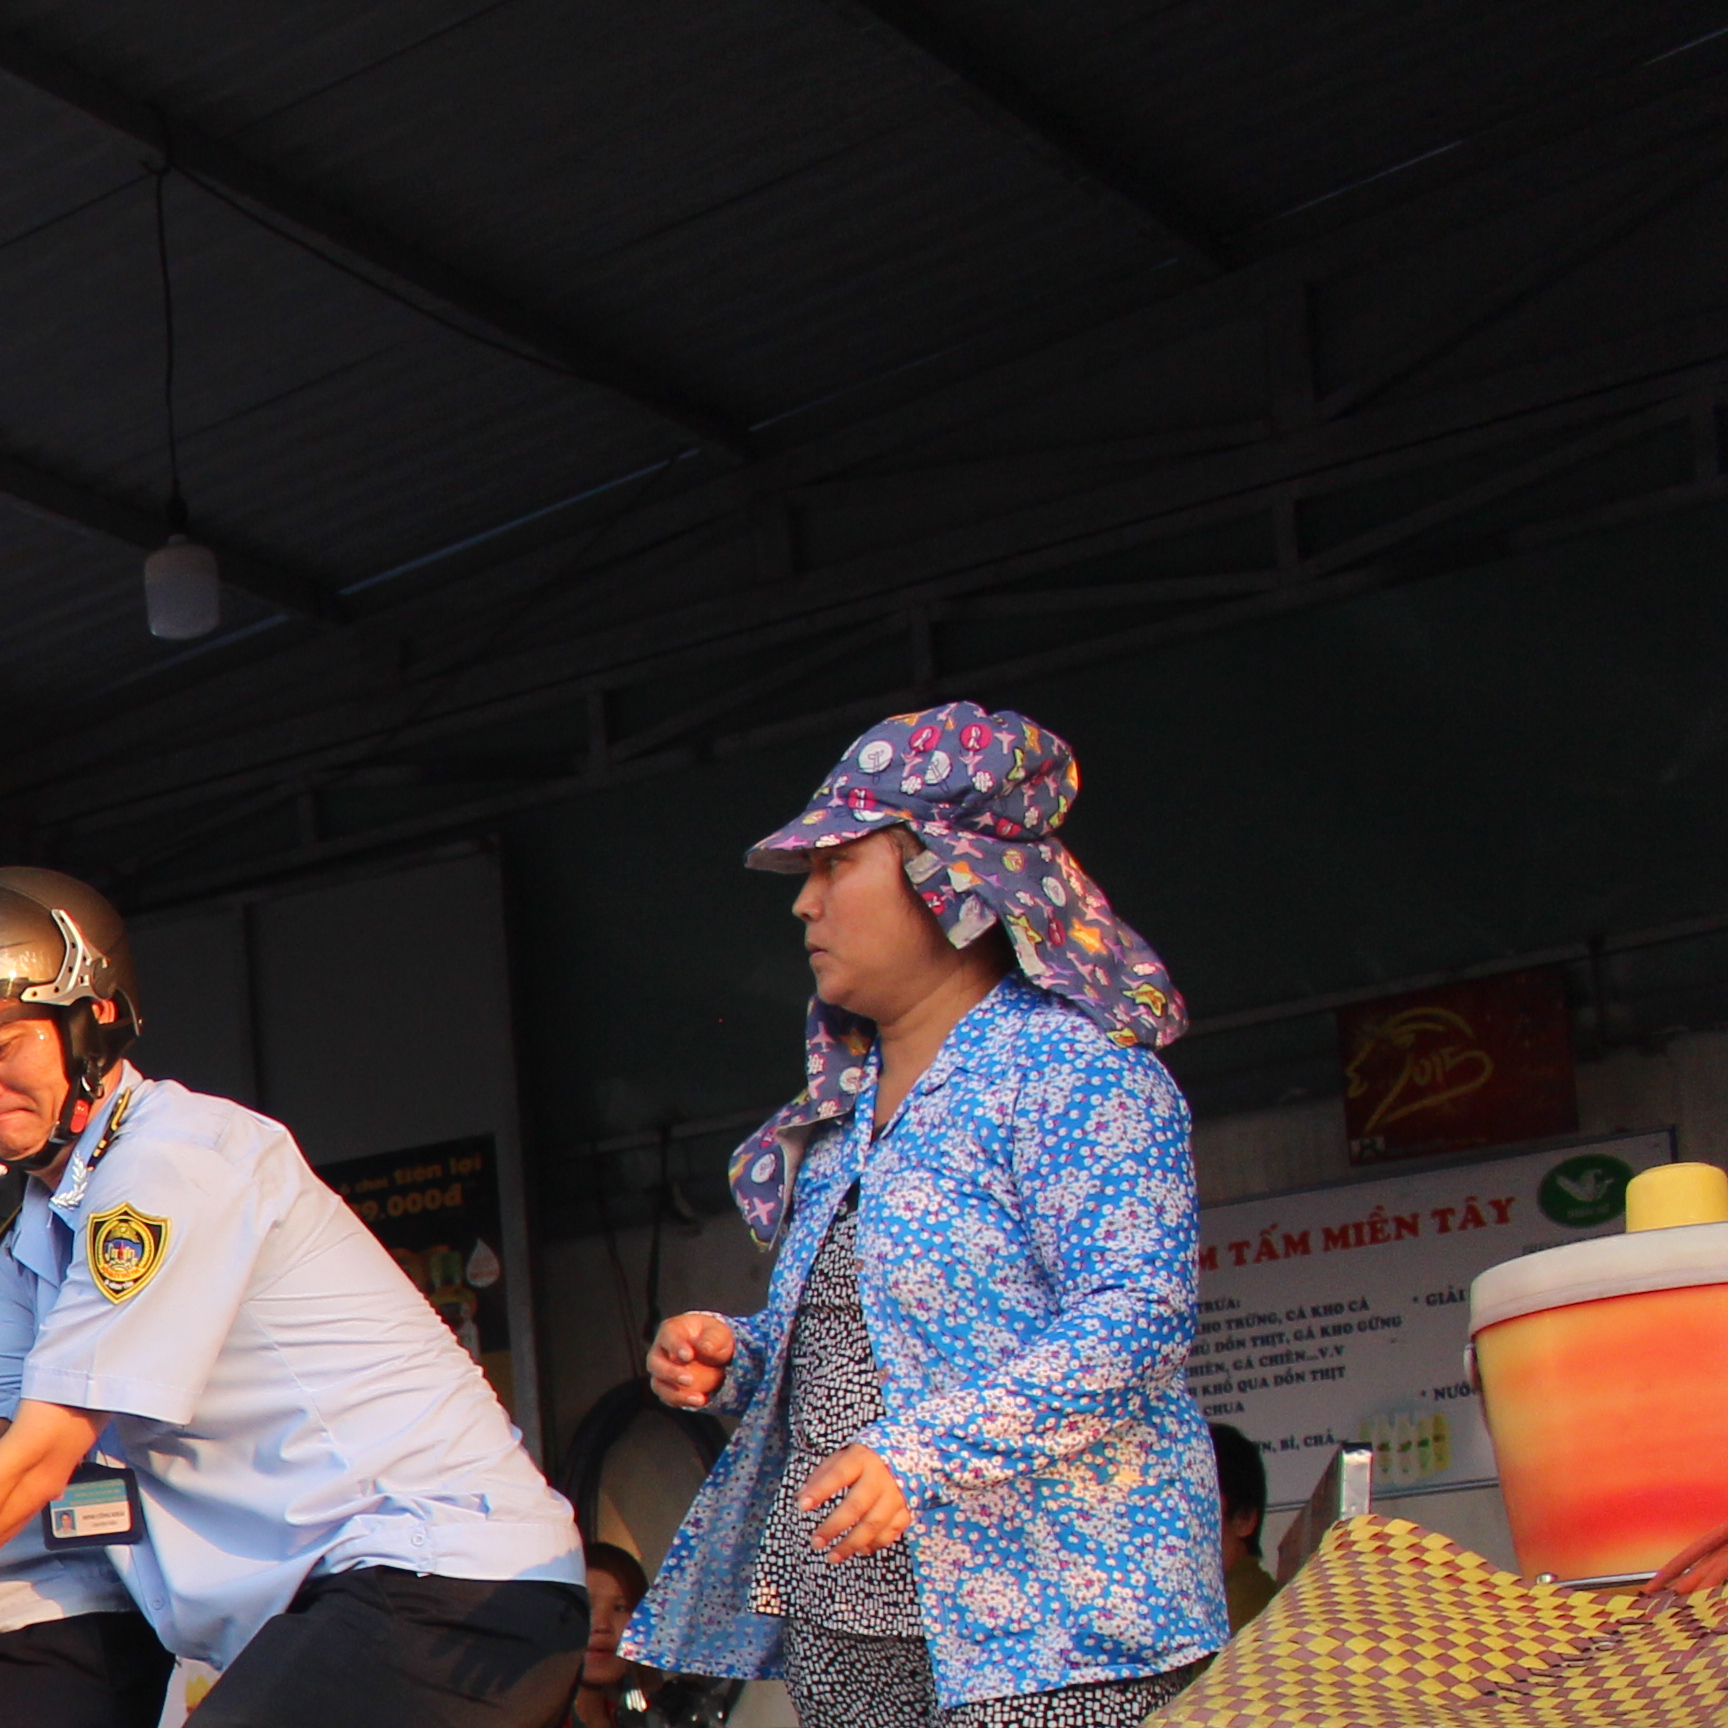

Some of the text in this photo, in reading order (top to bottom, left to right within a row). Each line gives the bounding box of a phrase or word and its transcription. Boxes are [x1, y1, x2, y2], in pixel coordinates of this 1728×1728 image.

[1228, 1222, 1311, 1266] TẤM
[1321, 1205, 1421, 1253] MIỀN
[1430, 1195, 1518, 1235] TÂY
